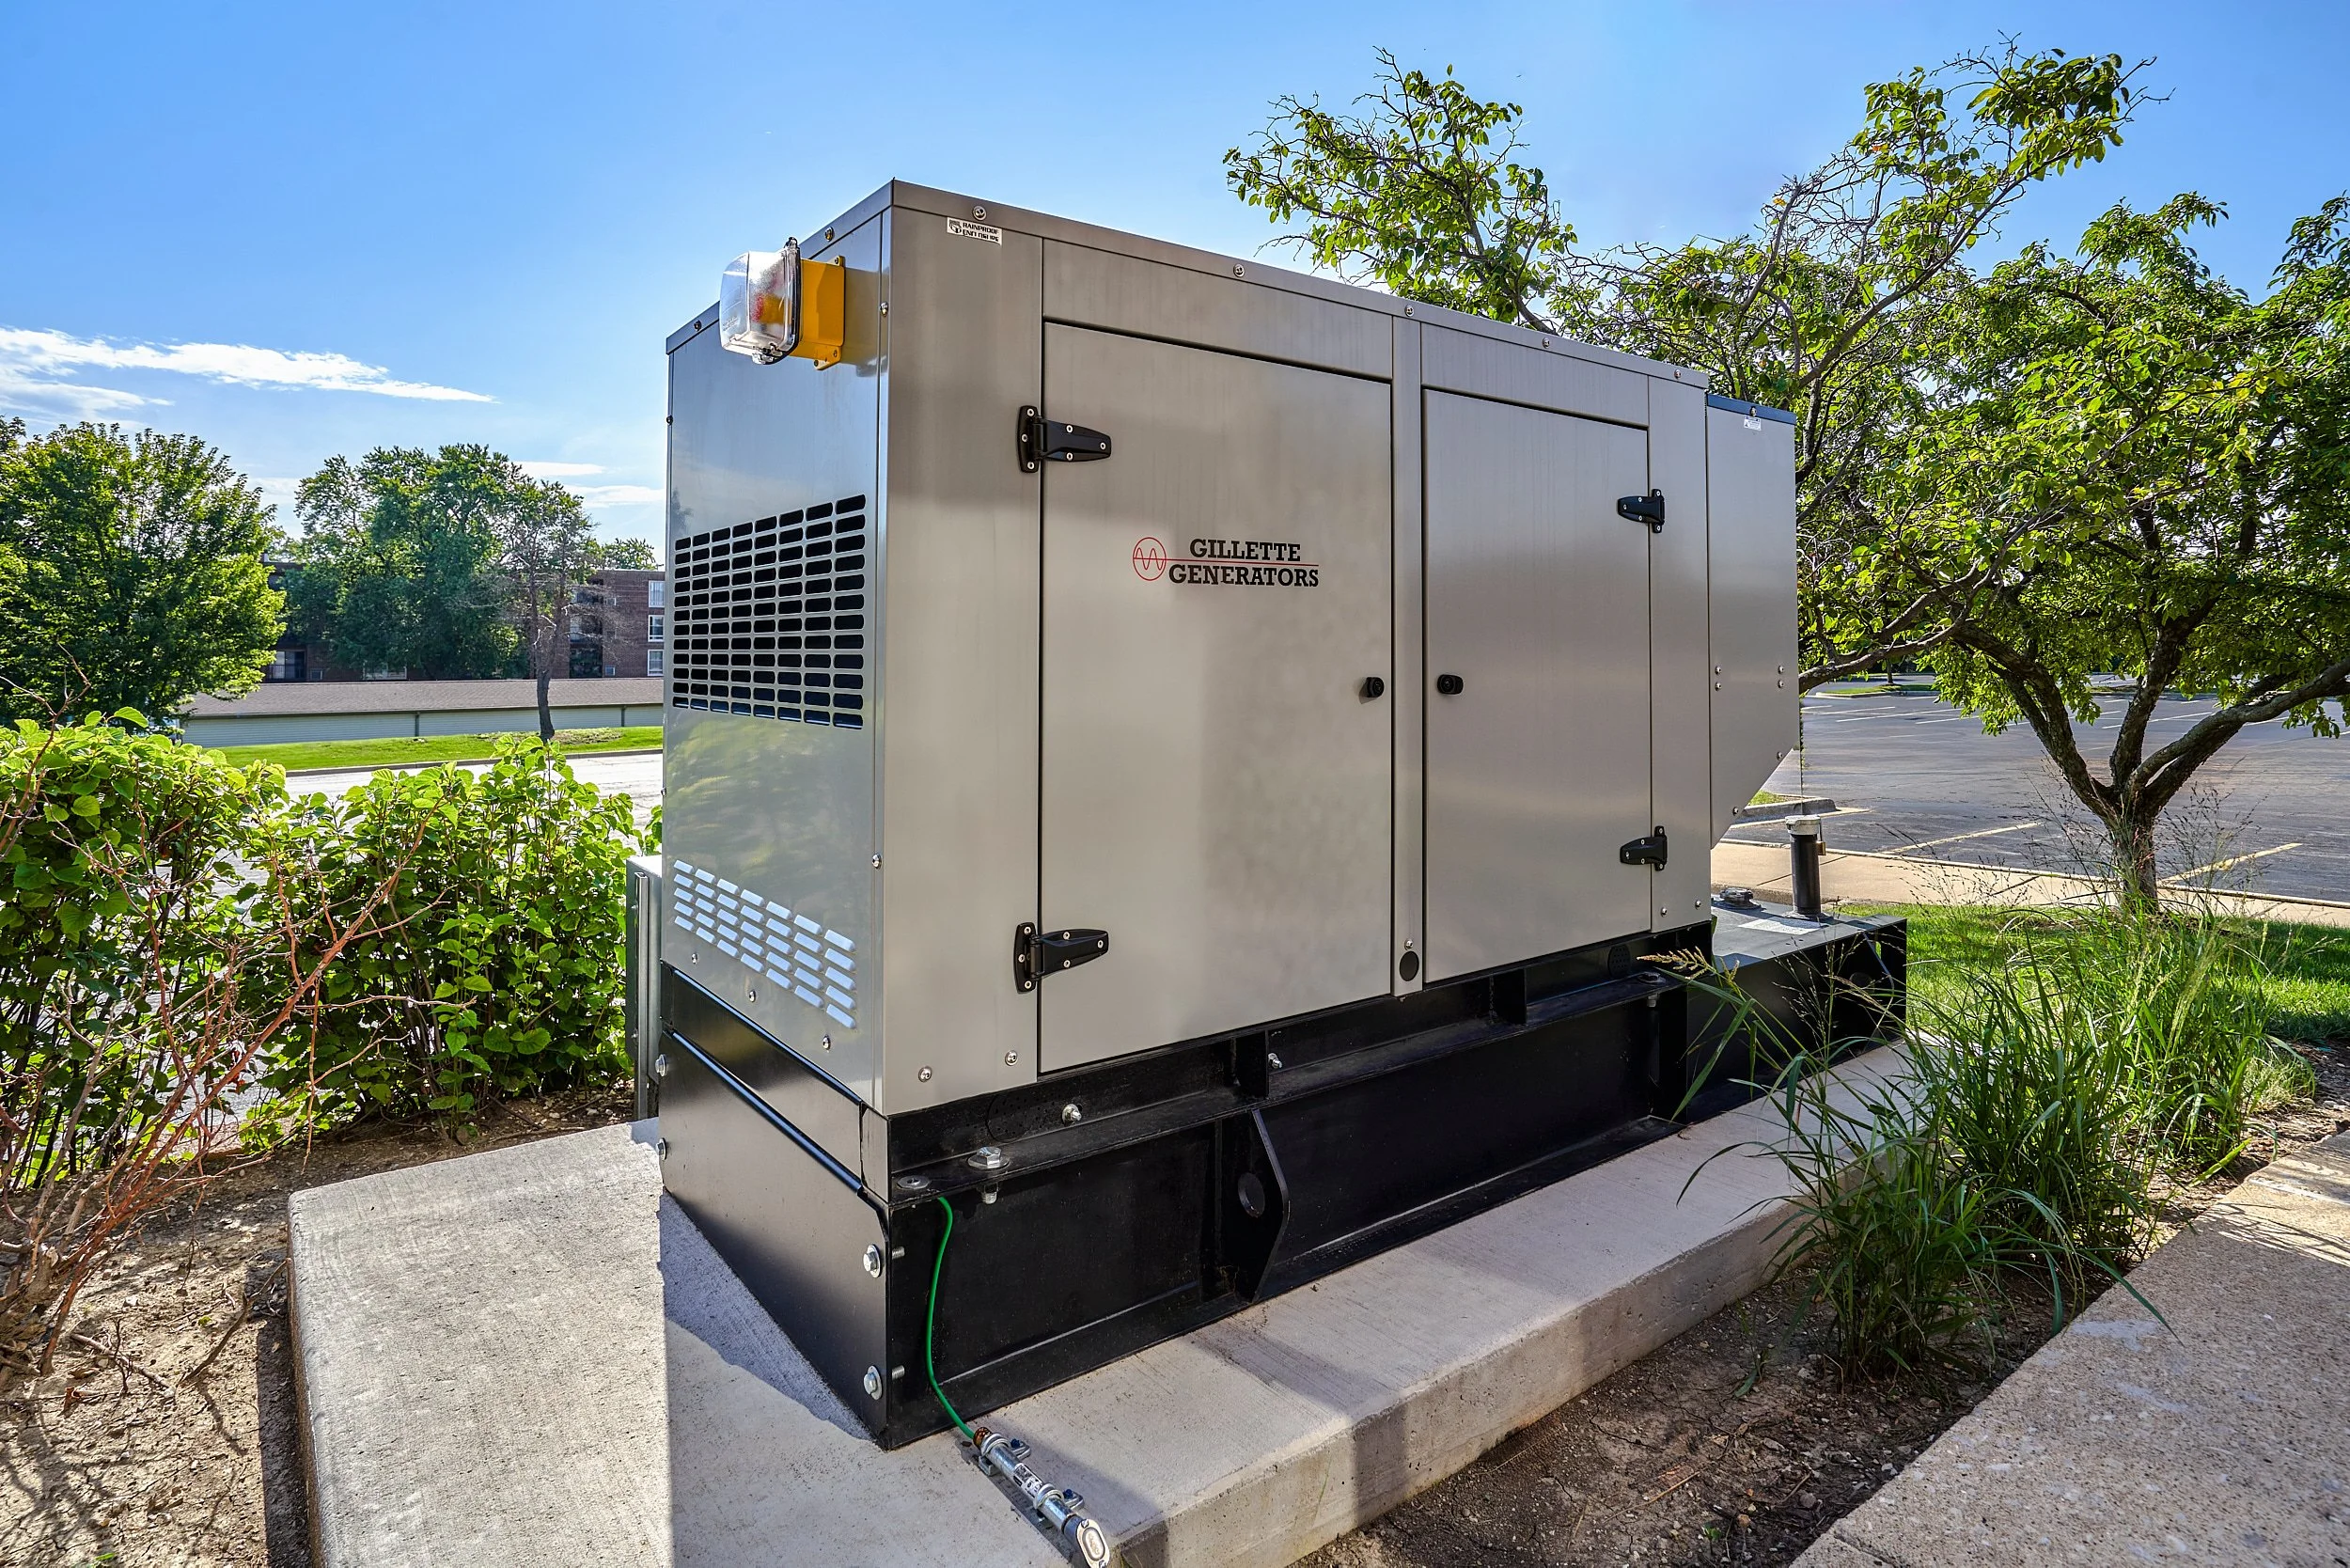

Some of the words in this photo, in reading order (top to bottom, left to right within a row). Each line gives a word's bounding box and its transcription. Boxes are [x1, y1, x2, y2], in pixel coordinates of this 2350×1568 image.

[963, 222, 999, 235] RAINPROOF
[1189, 538, 1301, 562] GILLETTE
[1168, 564, 1319, 588] GENERATORS
